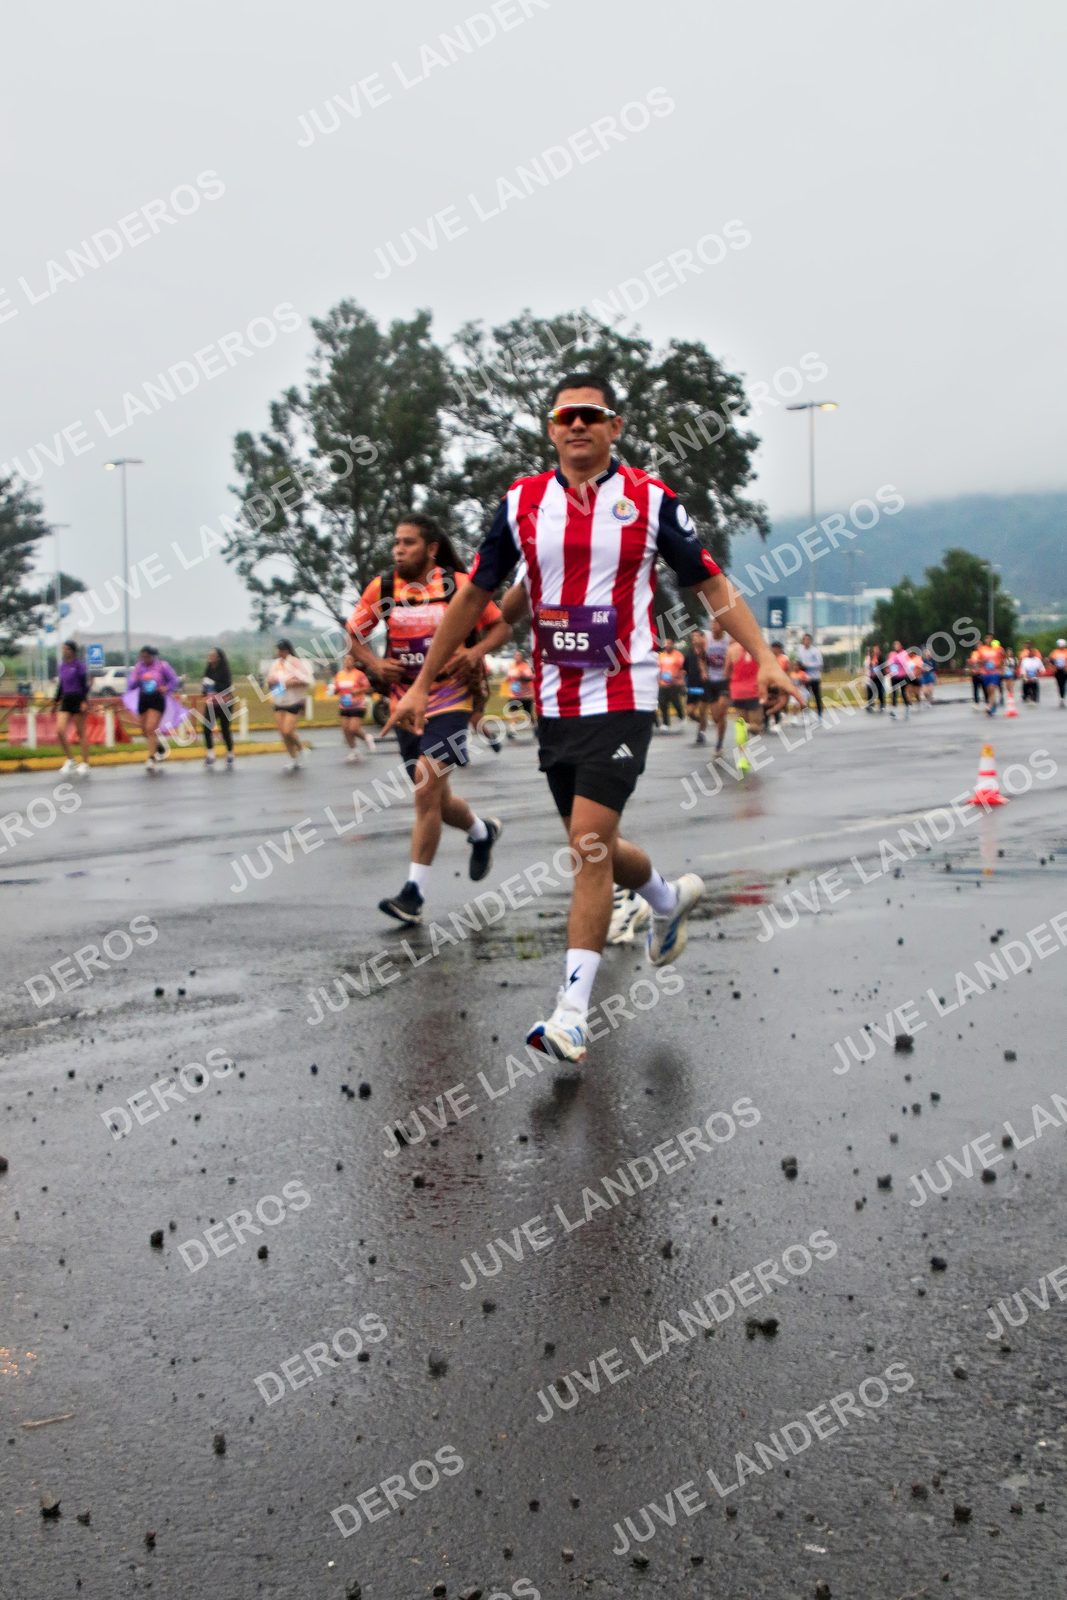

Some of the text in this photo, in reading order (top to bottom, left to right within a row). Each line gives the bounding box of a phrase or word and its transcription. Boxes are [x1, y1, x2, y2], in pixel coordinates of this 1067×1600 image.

[591, 610, 610, 624] 15K
[770, 609, 783, 625] E
[552, 631, 589, 651] 655
